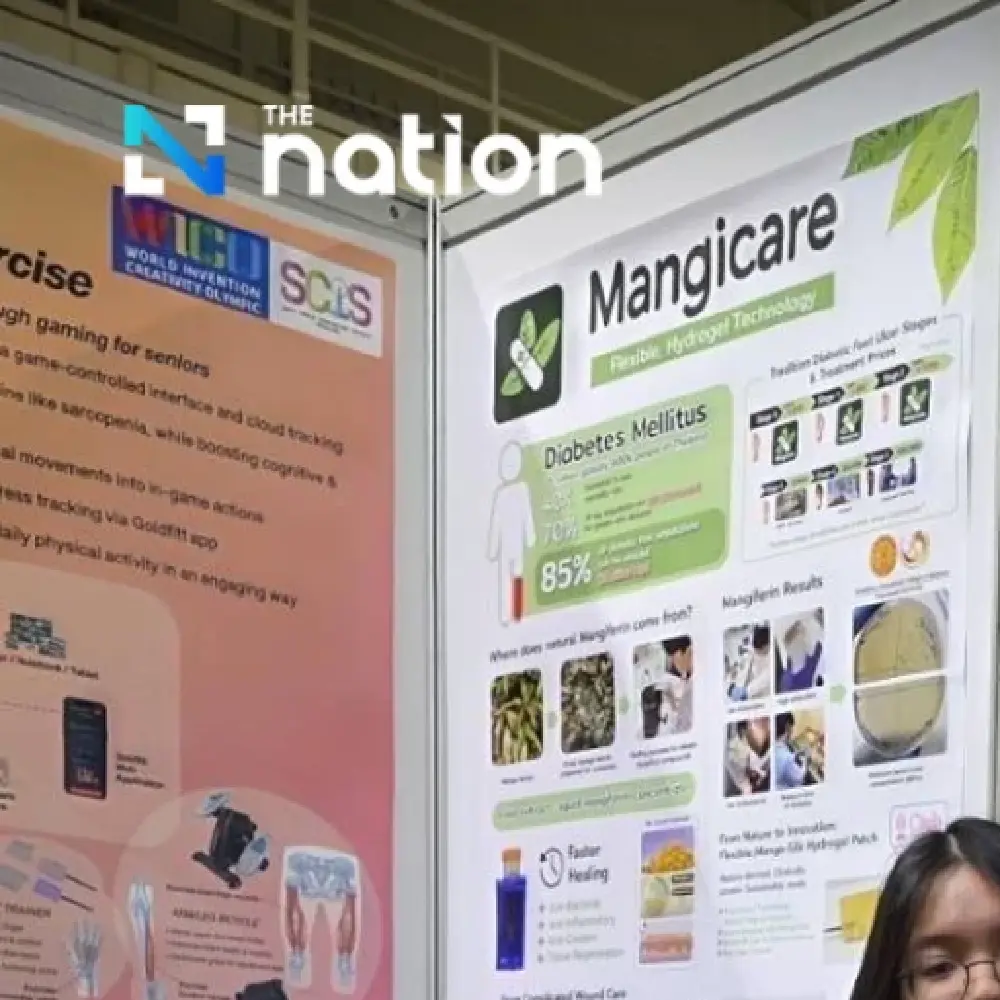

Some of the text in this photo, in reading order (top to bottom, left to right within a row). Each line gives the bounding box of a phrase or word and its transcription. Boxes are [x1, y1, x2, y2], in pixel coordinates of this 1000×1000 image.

[124, 245, 262, 300] WORLD INVENTION
[124, 260, 263, 315] CREATIVITY OLYMPIC
[590, 193, 838, 334] Mangicare
[36, 316, 109, 352] gaming
[114, 335, 141, 356] for
[144, 347, 210, 378] seniors
[610, 292, 817, 373] Flexible Hydrogel Technology
[14, 349, 146, 396] game-controlled
[150, 383, 213, 415] interface
[217, 403, 243, 424] and
[246, 413, 285, 438] cloud
[288, 425, 344, 457] tracking
[28, 390, 57, 411] like
[156, 427, 194, 448] while
[197, 437, 259, 470] boosting
[262, 456, 324, 485] cognitive
[544, 430, 626, 470] Diabetes
[631, 403, 708, 443] Mellitus
[20, 451, 112, 483] movements
[116, 472, 146, 493] into
[149, 481, 210, 512] in-game
[213, 500, 264, 523] actions
[37, 493, 102, 524] tracking
[105, 508, 128, 526] via
[191, 532, 218, 552] app
[35, 534, 101, 562] physical
[105, 550, 158, 577] activity
[163, 561, 177, 576] in
[181, 568, 197, 582] an
[200, 573, 266, 602] engaging
[269, 590, 297, 609] way
[541, 552, 592, 592] 85%
[782, 574, 824, 596] Results
[567, 844, 602, 860] Faster
[567, 866, 610, 885] Healing
